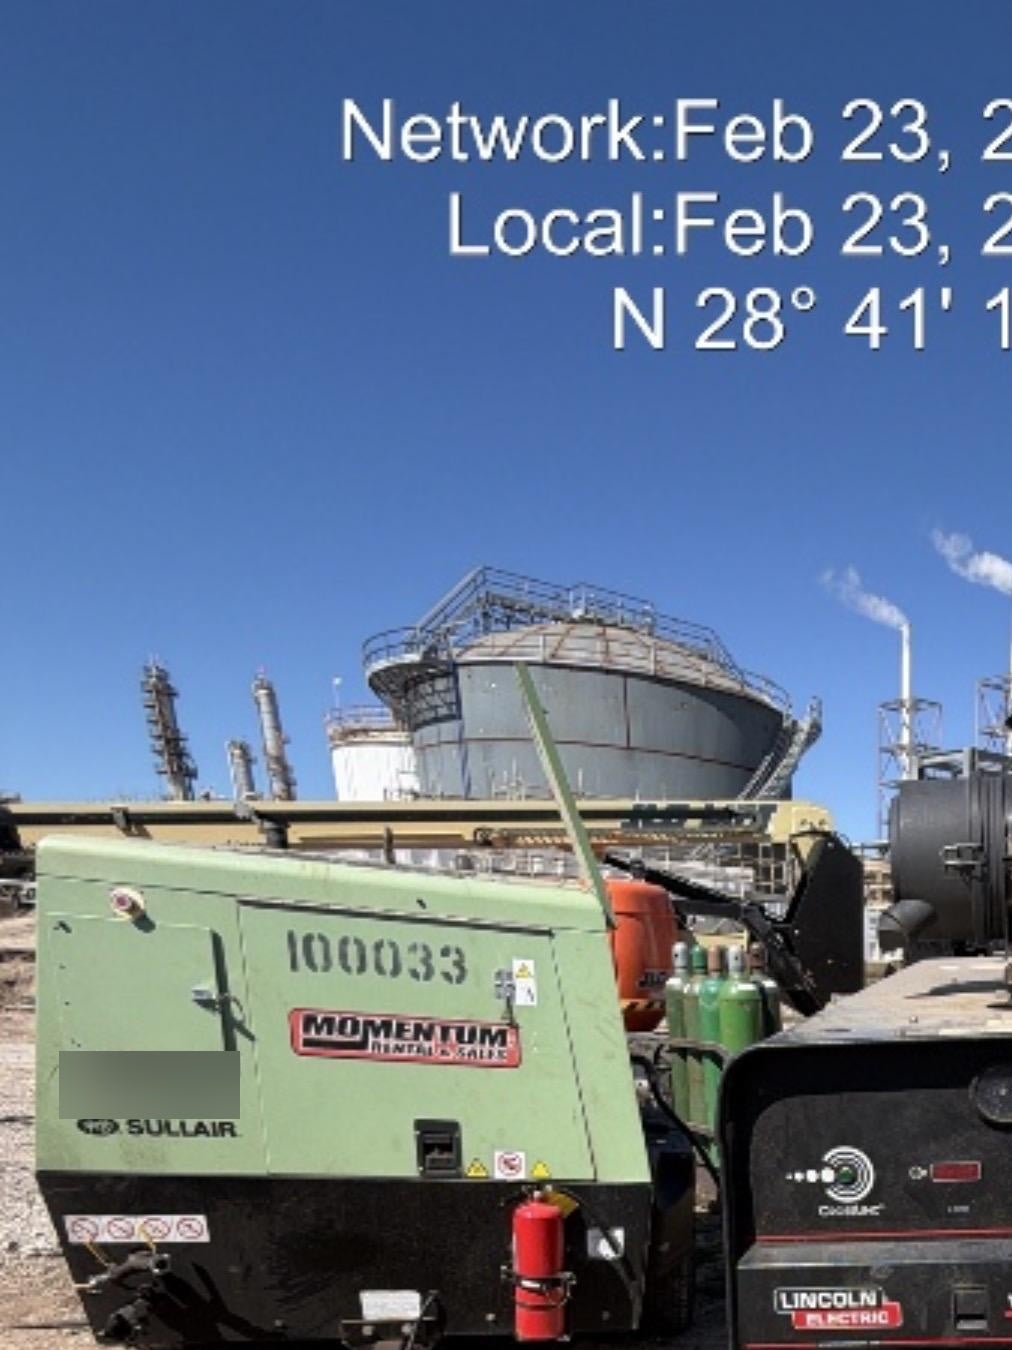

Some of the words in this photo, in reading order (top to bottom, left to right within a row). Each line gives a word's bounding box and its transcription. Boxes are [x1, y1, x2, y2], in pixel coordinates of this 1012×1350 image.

[287, 930, 468, 985] 100033
[302, 1014, 508, 1048] MOMENTUM
[371, 1041, 433, 1057] RENTAL
[458, 1047, 507, 1060] SALES
[126, 1119, 238, 1138] SULLAIR
[780, 1290, 877, 1310] LINCOLN
[805, 1311, 889, 1326] ELECTRIC
